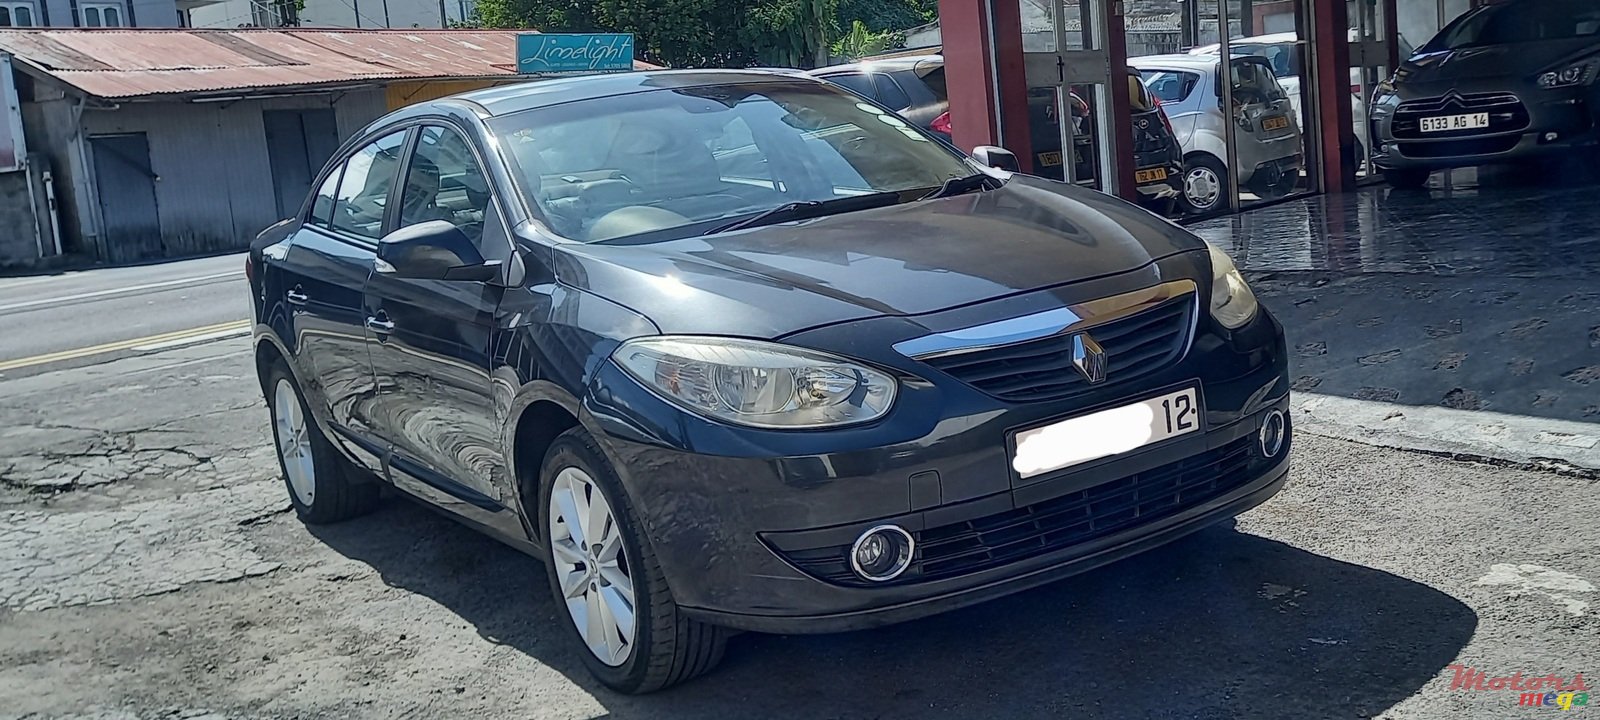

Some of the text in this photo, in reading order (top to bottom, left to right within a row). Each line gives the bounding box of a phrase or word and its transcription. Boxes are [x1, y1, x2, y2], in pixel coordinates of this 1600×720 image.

[521, 36, 631, 69] Limelight
[1422, 114, 1486, 130] 6133 AG 14
